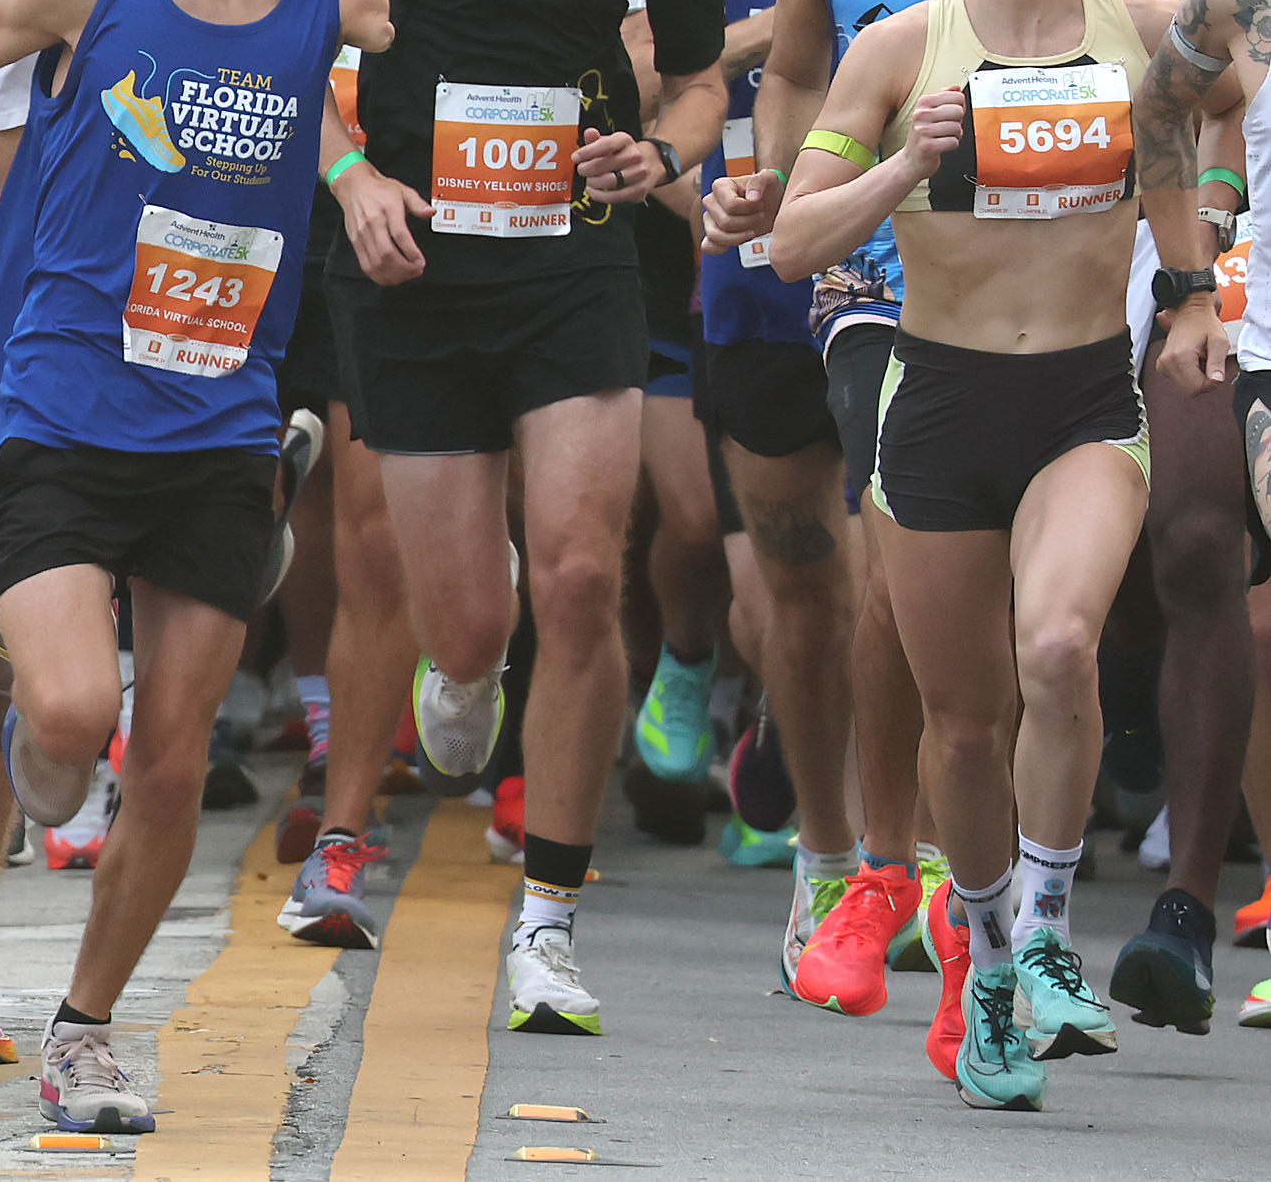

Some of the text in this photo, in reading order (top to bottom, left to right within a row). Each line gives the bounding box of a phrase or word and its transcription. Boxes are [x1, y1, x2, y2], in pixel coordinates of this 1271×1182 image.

[218, 68, 272, 90] TEAM
[180, 80, 297, 117] FLORIDA
[171, 102, 288, 139] VIRTUAL
[178, 128, 283, 160] SCHOOL
[1000, 116, 1111, 154] 5694
[205, 156, 267, 175] Stepping Up
[458, 137, 558, 171] 1002
[191, 165, 271, 185] For Our Stud
[437, 177, 568, 192] DISNEY YELLOW SHOES
[1058, 189, 1121, 209] RUNNER
[509, 213, 567, 228] RUNNER
[146, 262, 244, 308] 1243
[163, 310, 204, 326] VIRTUAL
[206, 318, 248, 334] SCHOOL
[176, 349, 241, 371] RUNNER
